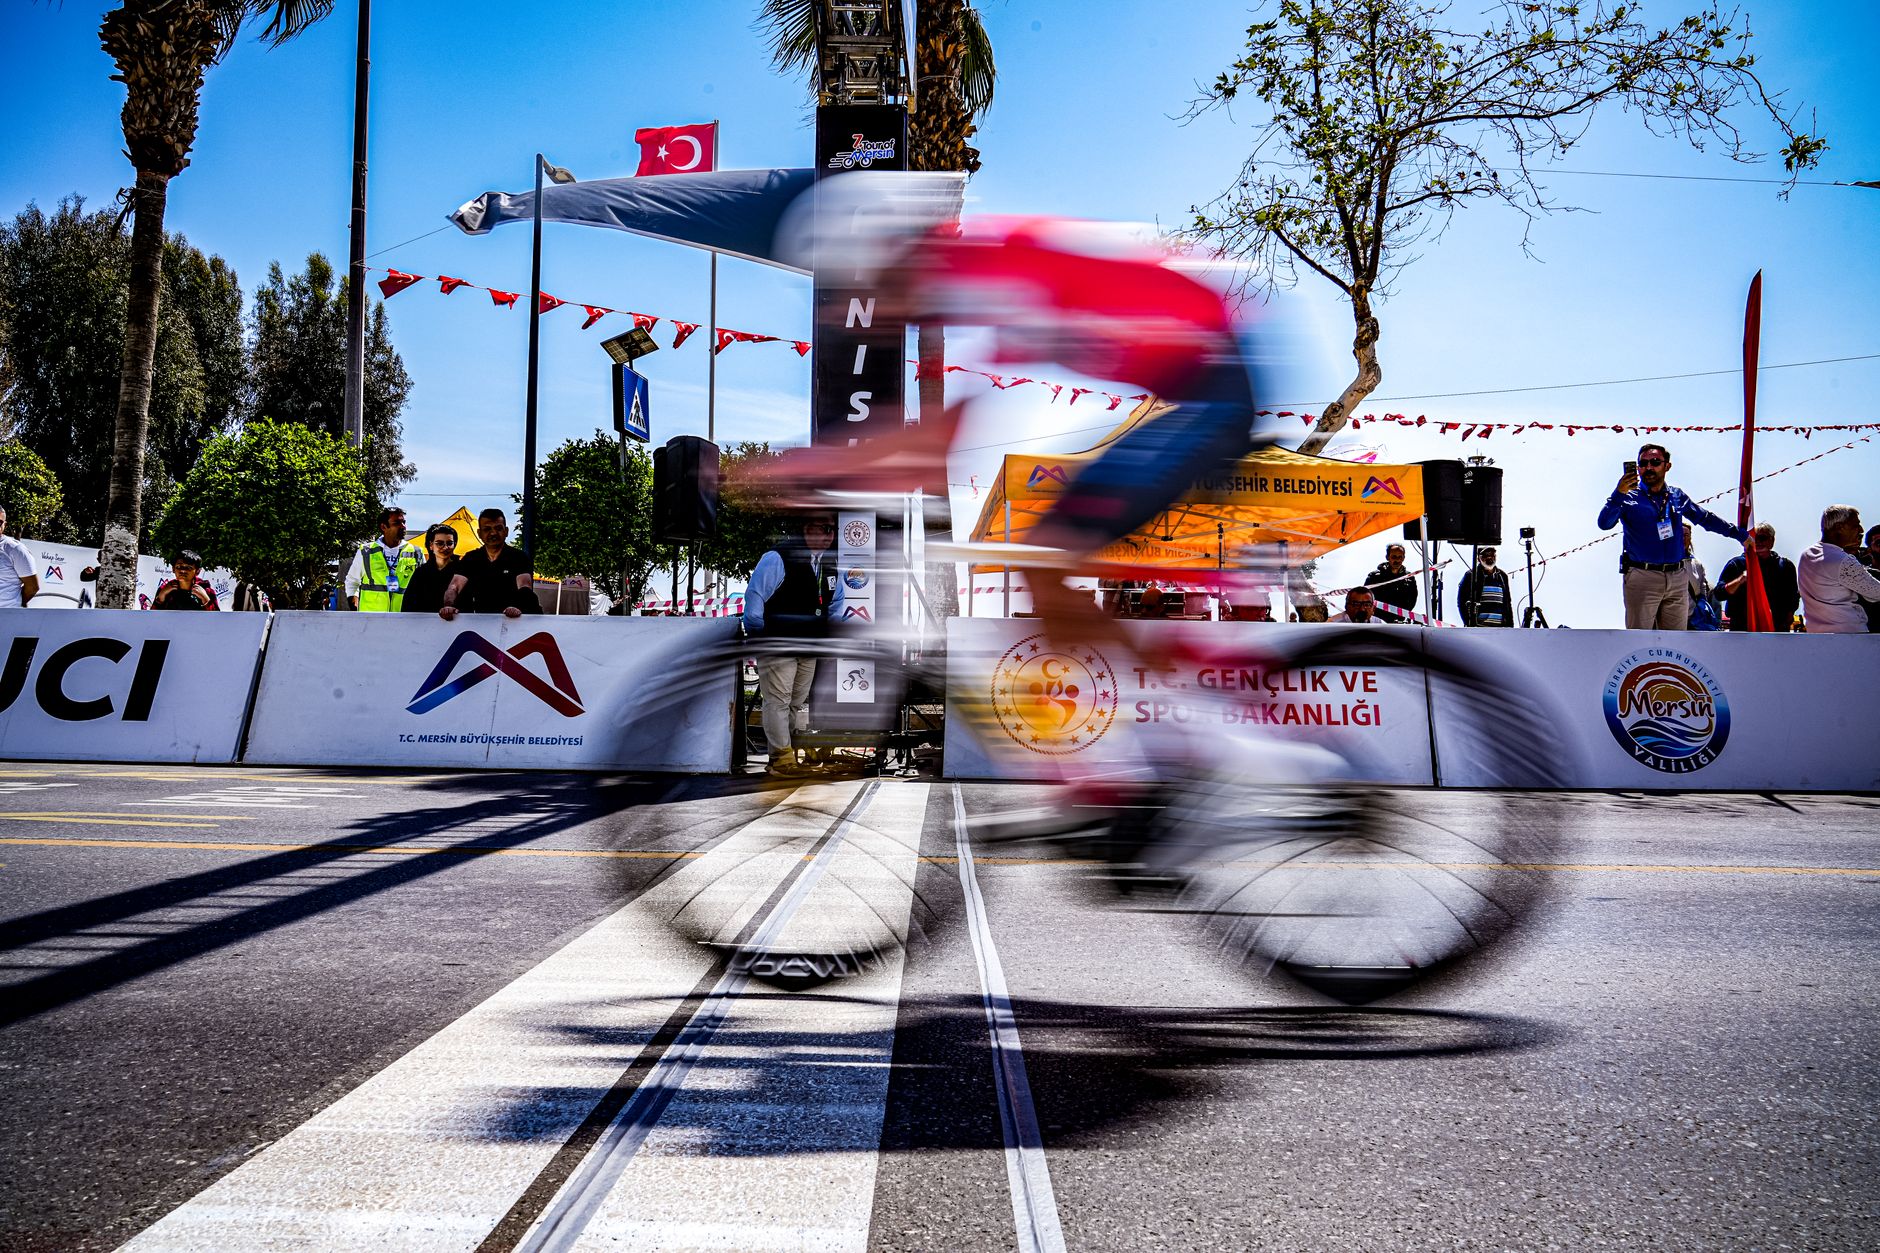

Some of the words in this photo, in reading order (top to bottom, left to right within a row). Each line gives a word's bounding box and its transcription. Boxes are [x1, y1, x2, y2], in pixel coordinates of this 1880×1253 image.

[862, 140, 883, 151] Tour
[884, 138, 895, 150] of
[1273, 475, 1353, 497] BELEDİYESİ
[1133, 667, 1187, 690] T.C.
[1197, 667, 1330, 698] GENÇLİK
[1339, 670, 1378, 693] VE
[1608, 655, 1639, 695] TÜRKİYE
[1648, 649, 1722, 697] CUMHURİYETİ
[1222, 699, 1381, 726] BAKANLIĞI
[1618, 689, 1715, 719] Mersin
[399, 734, 416, 743] T.C.
[417, 732, 458, 743] MERSİN
[459, 732, 526, 746] BÜYÜKŞEHİR
[527, 734, 584, 746] BELEDİYESİ
[1634, 745, 1717, 772] VALİLİĞİ
